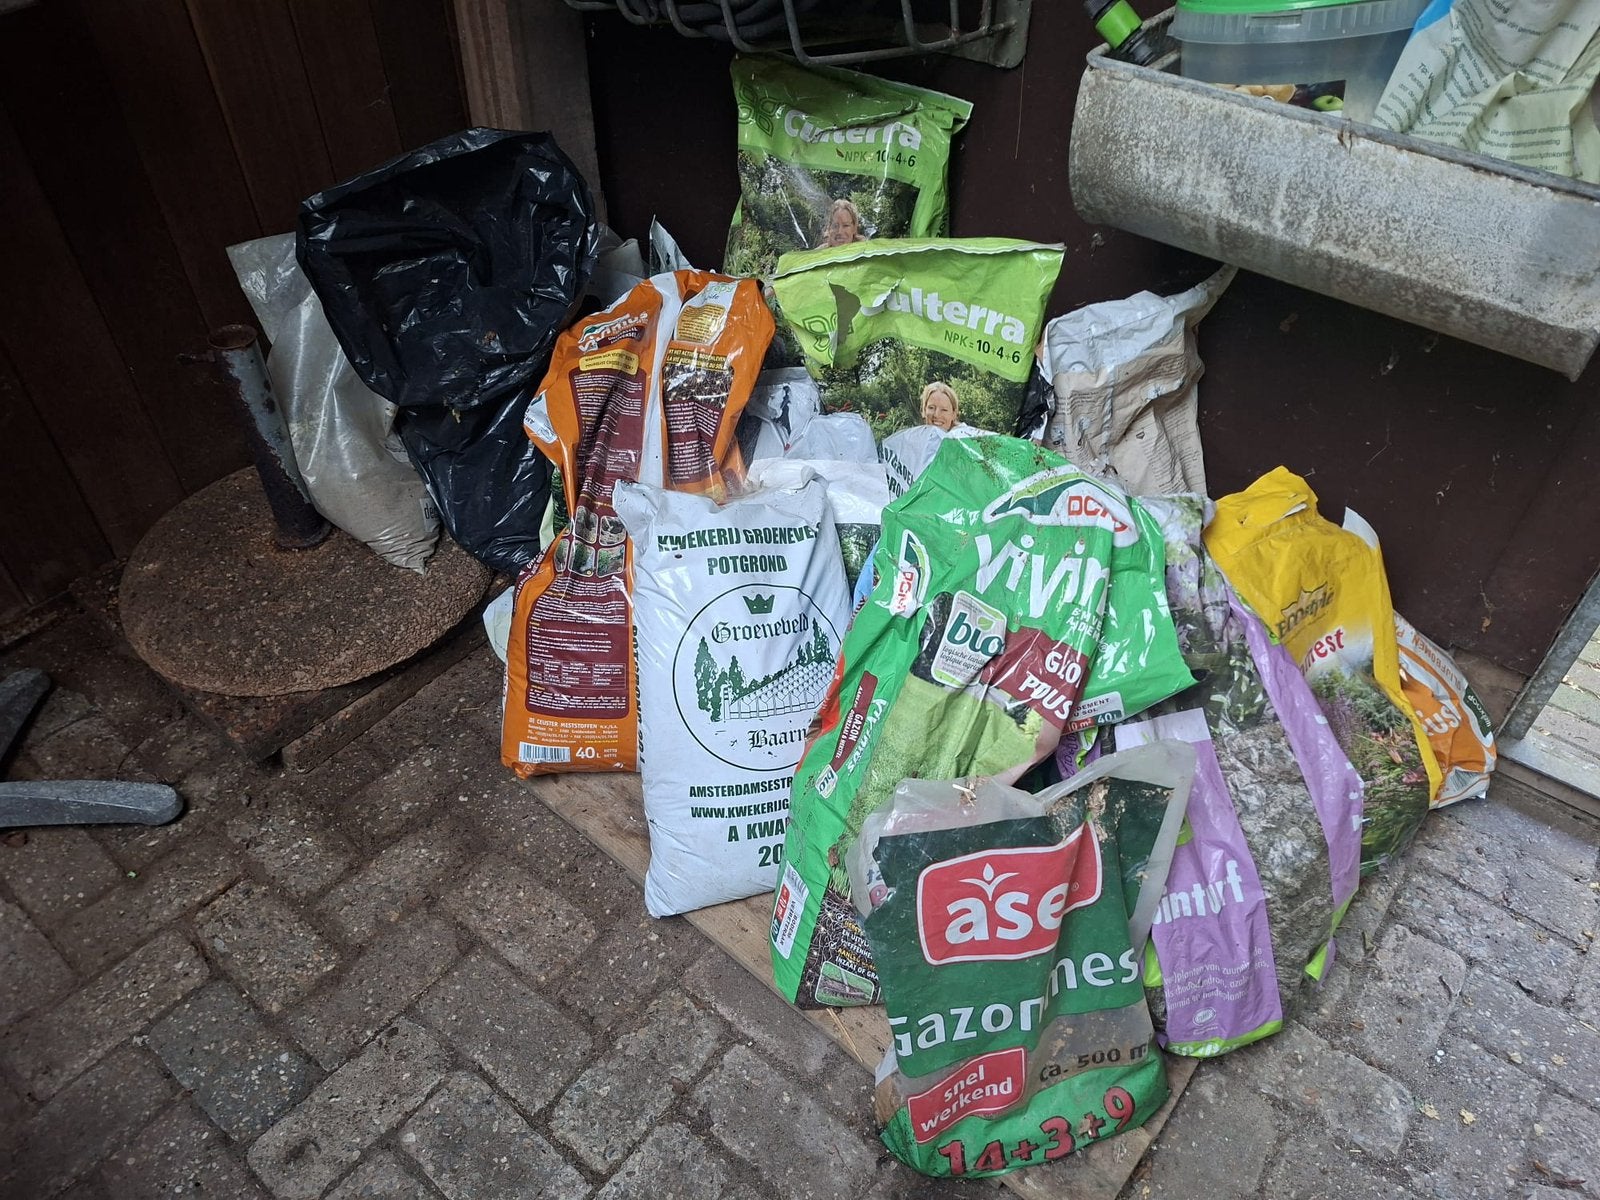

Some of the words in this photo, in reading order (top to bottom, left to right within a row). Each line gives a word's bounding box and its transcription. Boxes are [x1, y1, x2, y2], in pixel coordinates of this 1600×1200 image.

[844, 150, 866, 162] NPK
[944, 330, 968, 349] NPK
[657, 527, 742, 552] KWEKERIJ
[707, 554, 788, 576] POTGROND
[710, 612, 810, 644] Groeneveld
[946, 612, 1004, 657] bio
[848, 712, 864, 742] GAZON
[575, 746, 596, 759] 40
[748, 728, 807, 752] Baarn
[728, 826, 740, 842] A
[758, 843, 784, 868] 20
[1039, 1062, 1070, 1084] ca.
[1077, 1046, 1127, 1072] 500
[943, 1064, 986, 1103] snel
[920, 1075, 1013, 1134] werkend
[938, 1085, 1136, 1176] 14+3+9
